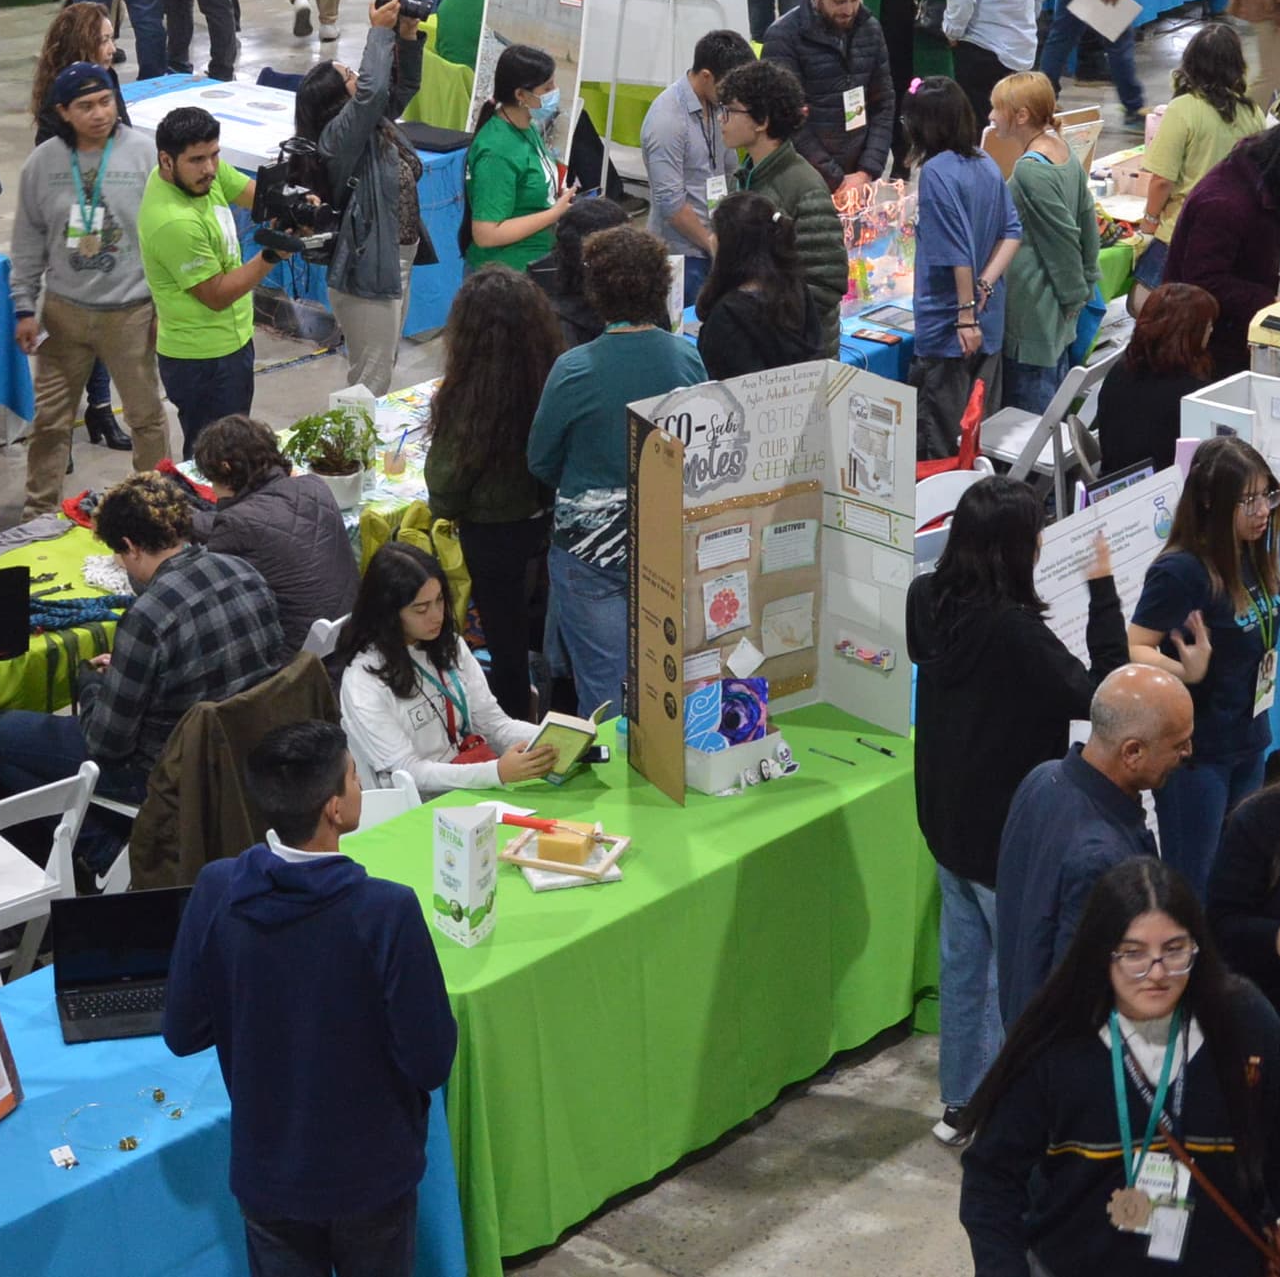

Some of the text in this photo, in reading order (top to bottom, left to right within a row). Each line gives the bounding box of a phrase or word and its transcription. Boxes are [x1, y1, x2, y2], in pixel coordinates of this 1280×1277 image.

[759, 434, 808, 461] CLUB DE
[752, 452, 826, 482] CIENCIAS
